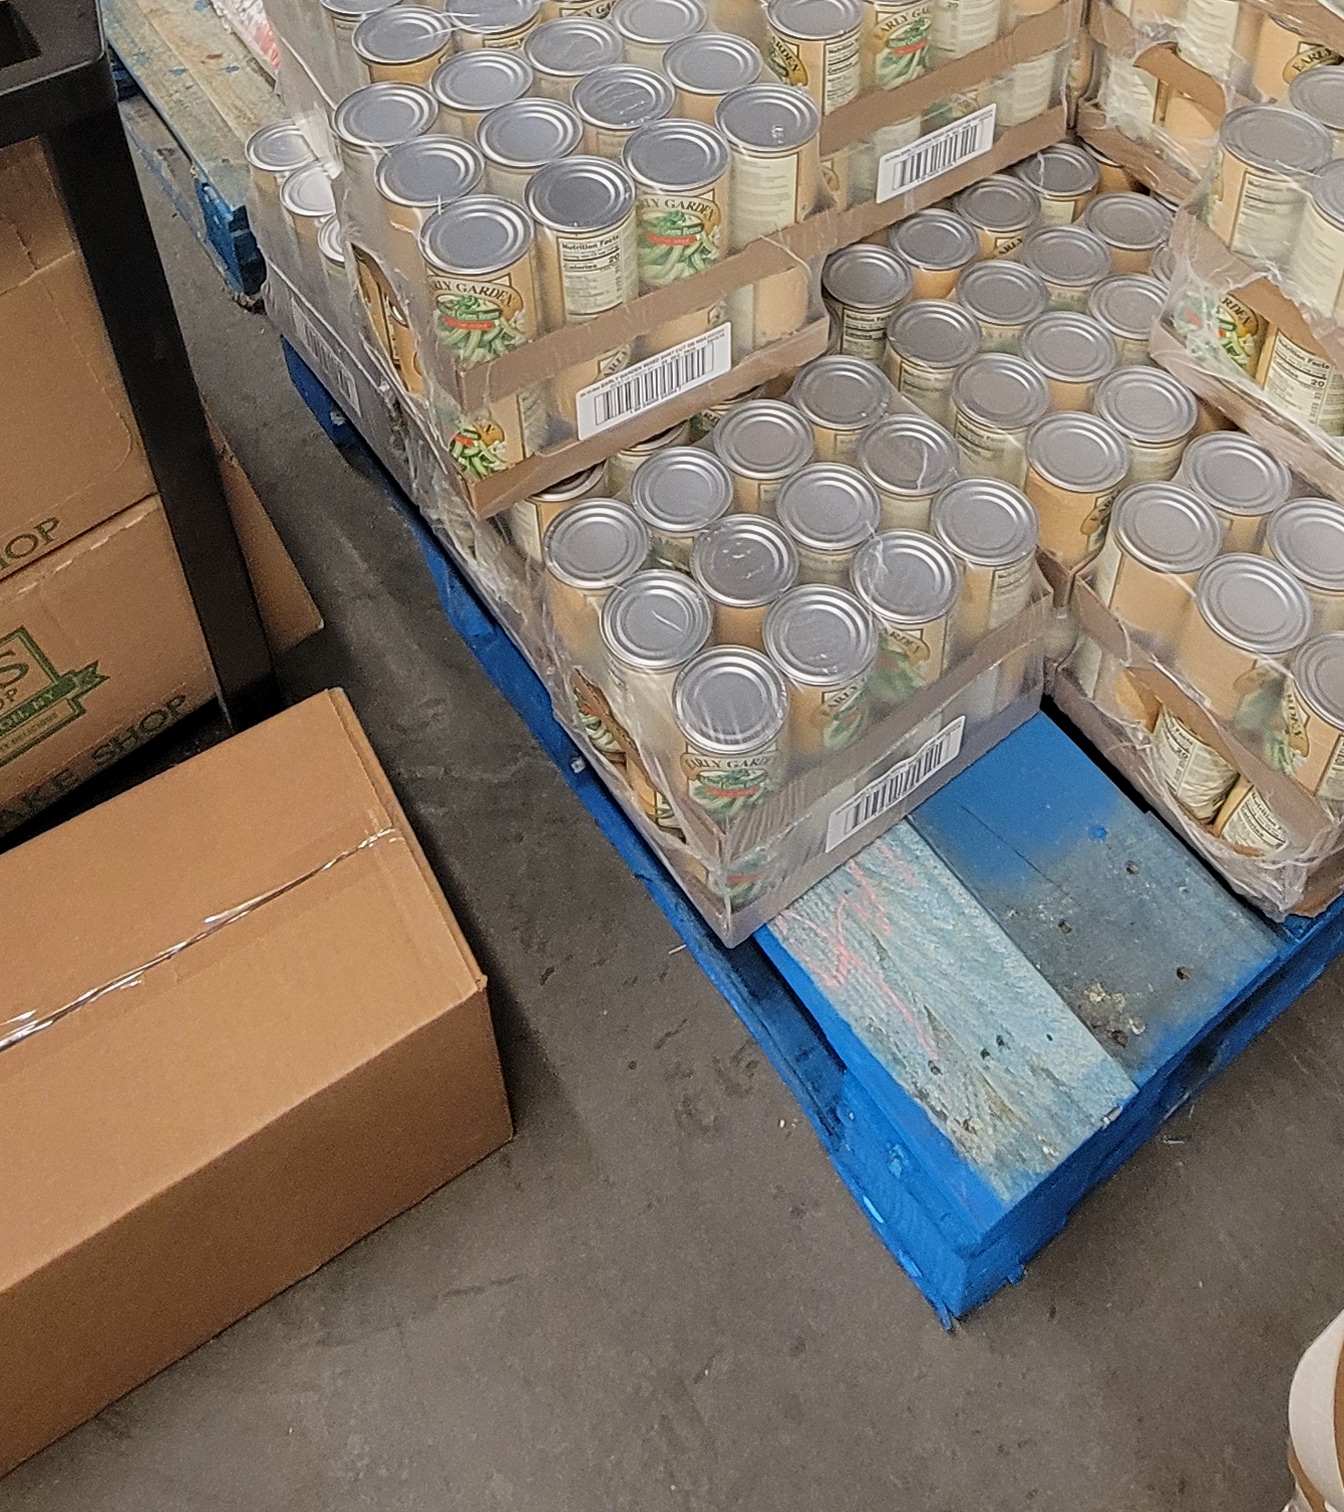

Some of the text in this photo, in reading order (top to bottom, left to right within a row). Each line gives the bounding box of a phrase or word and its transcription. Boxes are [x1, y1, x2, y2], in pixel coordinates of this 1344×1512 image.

[664, 199, 714, 222] GARDEN
[563, 234, 619, 252] Nutrition Facts
[564, 253, 620, 271] Calories 20
[456, 284, 515, 306] GARDEN
[1311, 379, 1325, 388] 20
[91, 695, 186, 767] SHOP
